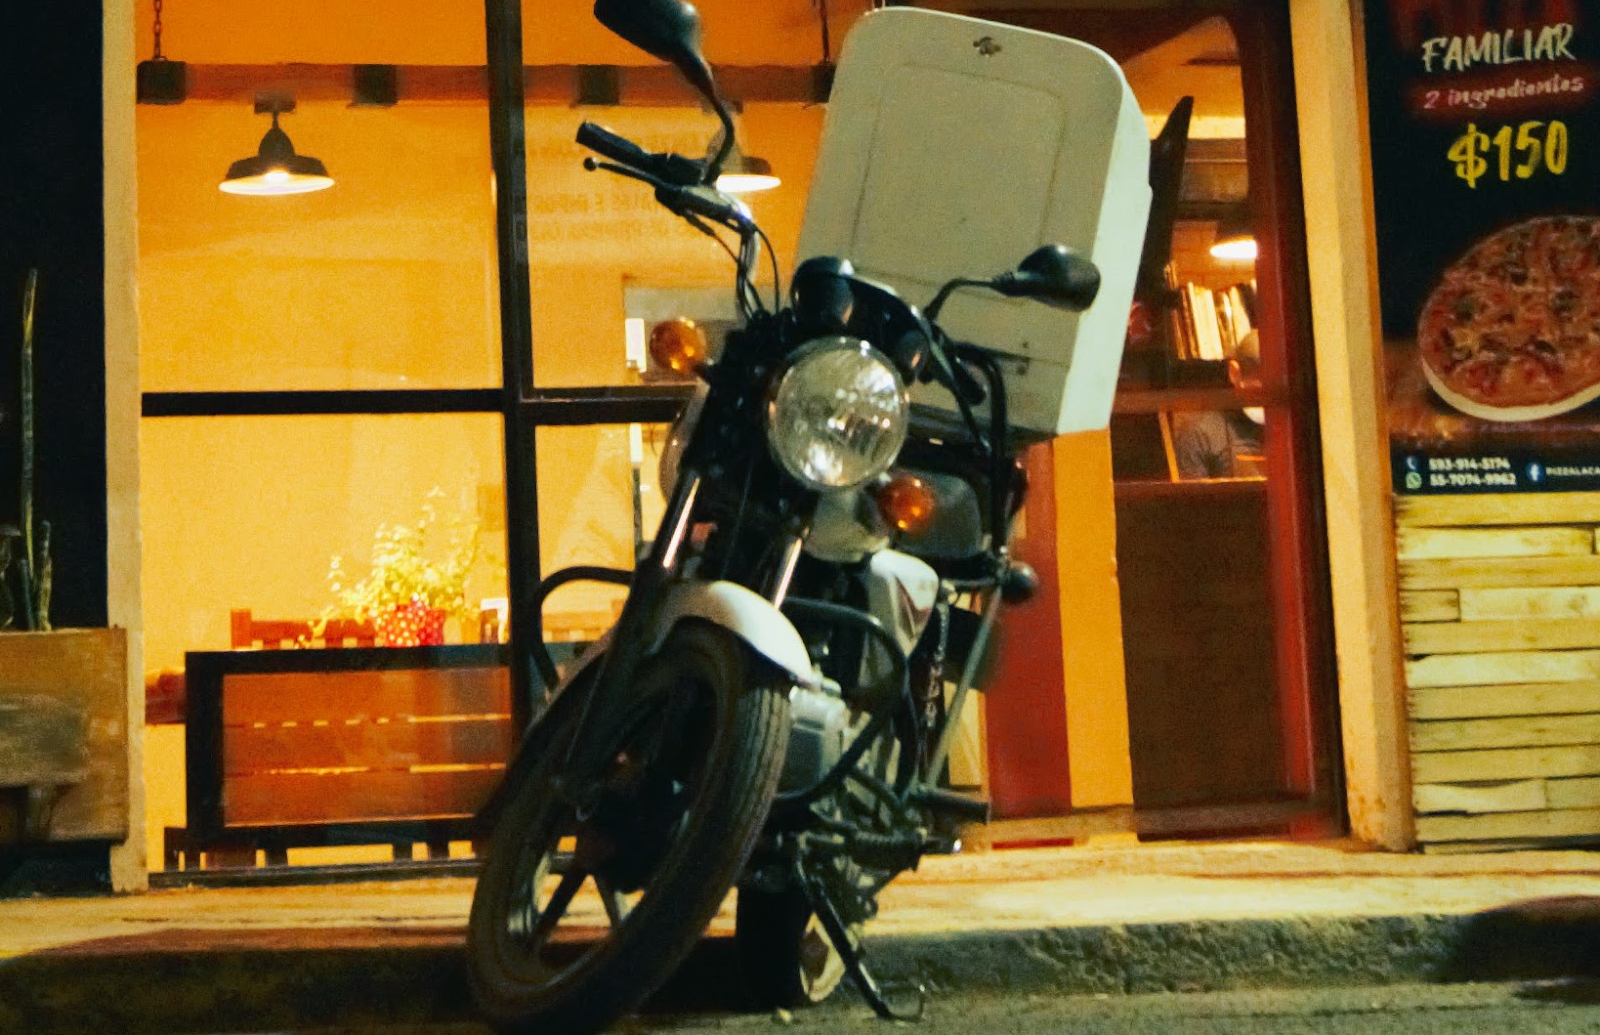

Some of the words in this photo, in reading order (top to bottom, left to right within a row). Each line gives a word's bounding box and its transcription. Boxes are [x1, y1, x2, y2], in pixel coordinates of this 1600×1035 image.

[1422, 22, 1577, 72] FAMILIAR
[1424, 90, 1440, 109] 2
[1448, 73, 1584, 109] ingredientes
[1447, 120, 1568, 189] $150
